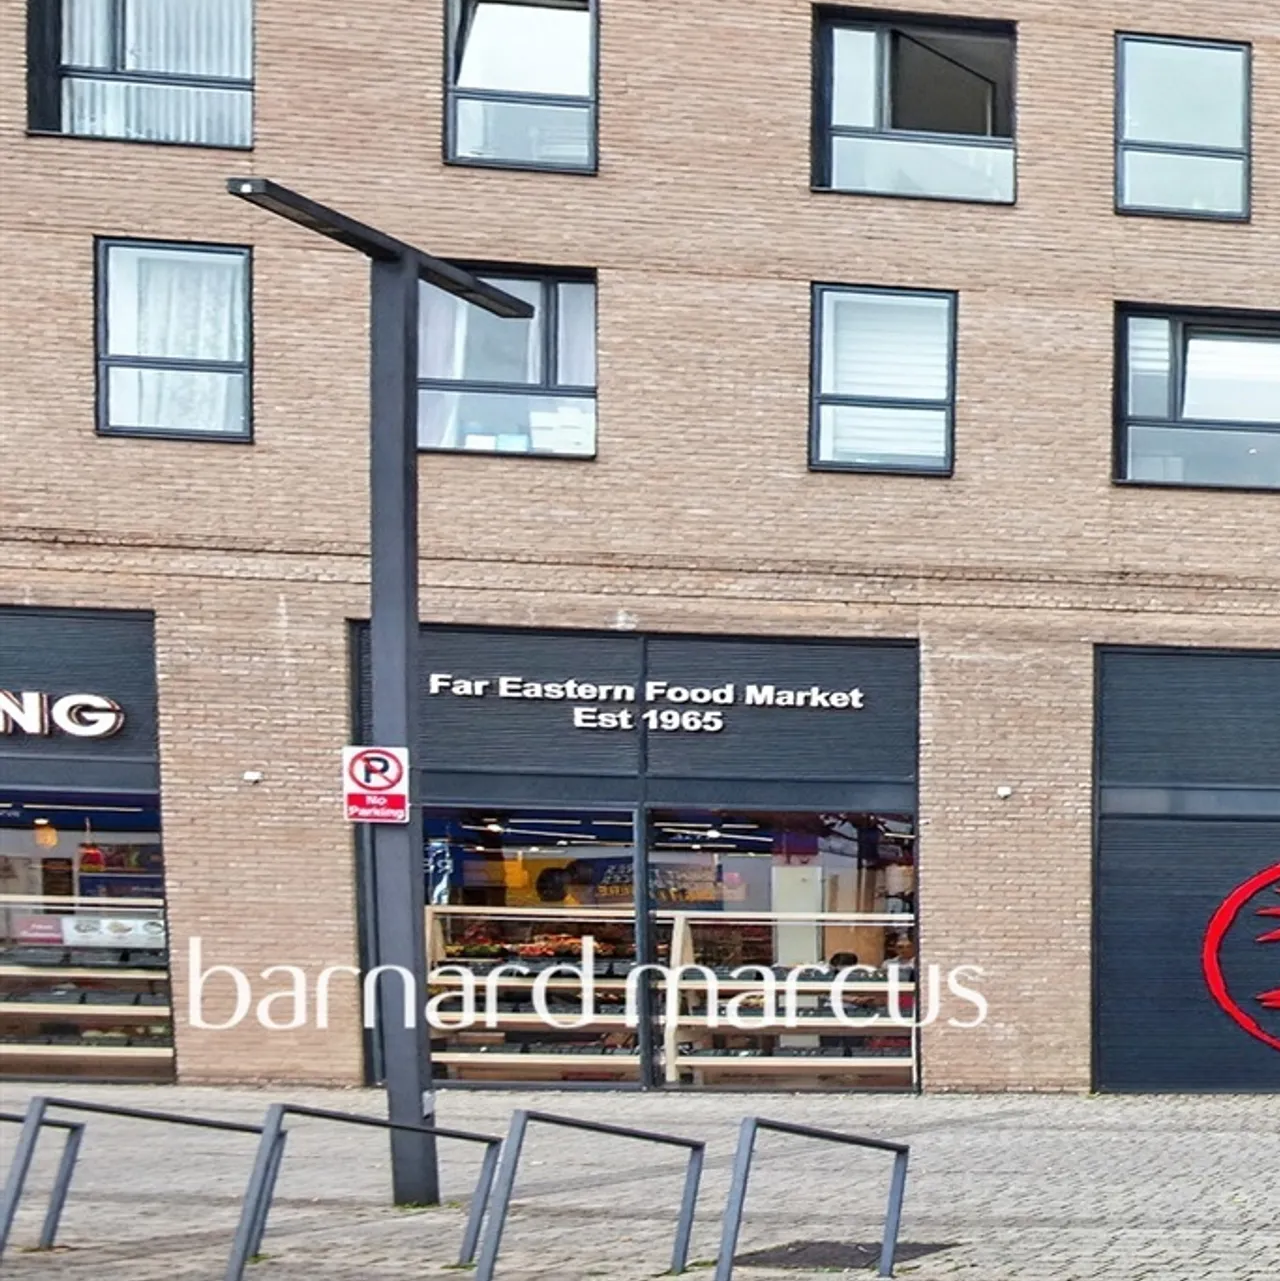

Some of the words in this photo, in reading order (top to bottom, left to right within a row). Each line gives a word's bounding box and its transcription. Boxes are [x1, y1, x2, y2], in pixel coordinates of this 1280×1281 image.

[428, 673, 490, 698] Far
[499, 676, 635, 703] Eastern
[645, 681, 735, 706] Food
[745, 685, 865, 710] Market
[573, 707, 633, 730] Est
[641, 709, 725, 733] 1965
[365, 795, 387, 806] No
[348, 806, 405, 819] Parking
